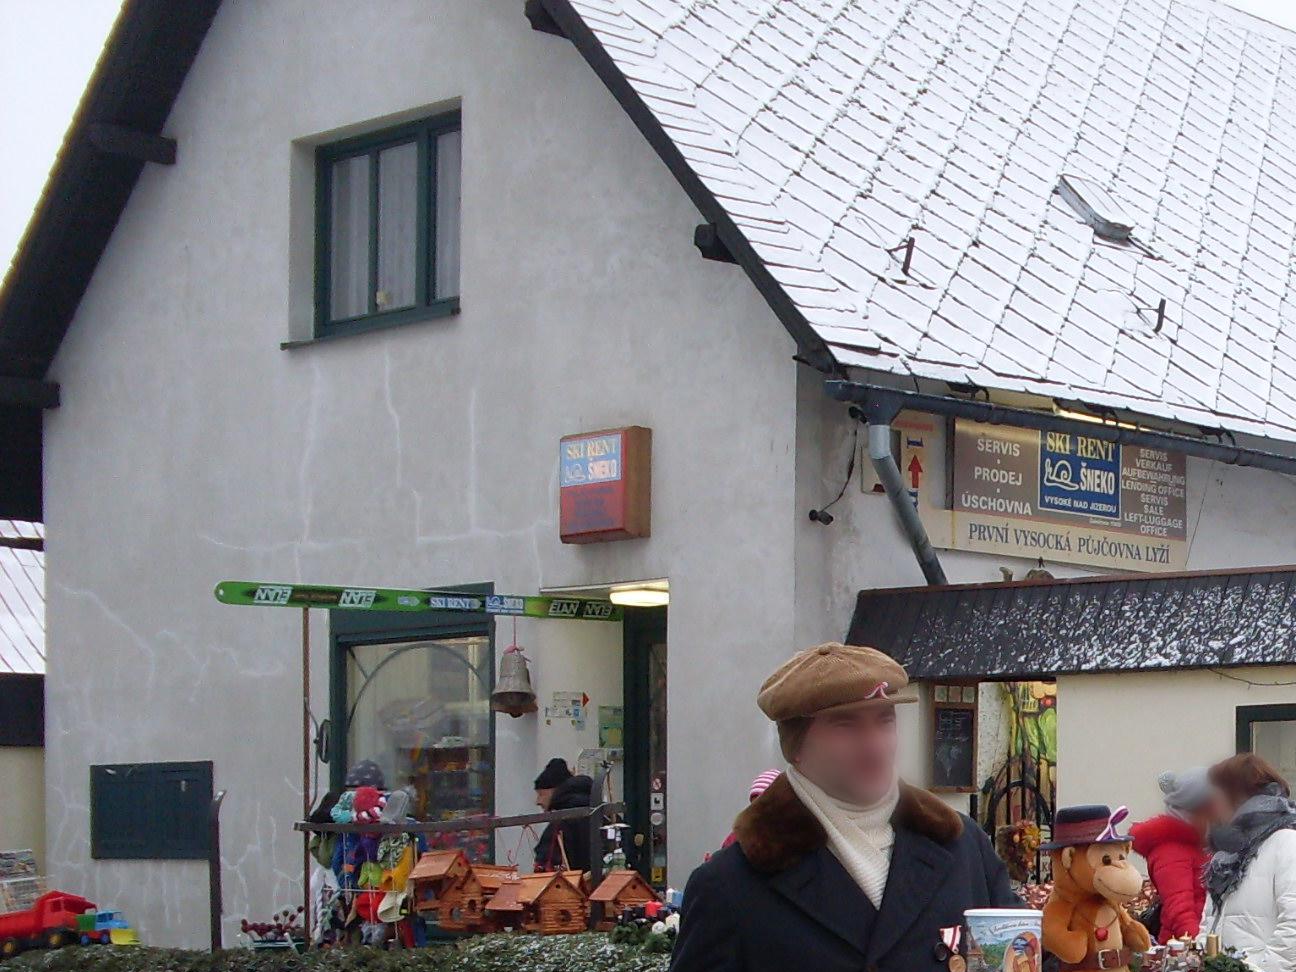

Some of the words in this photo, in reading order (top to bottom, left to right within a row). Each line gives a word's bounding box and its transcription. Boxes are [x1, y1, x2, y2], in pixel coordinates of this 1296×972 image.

[977, 438, 1020, 457] SERVIS
[1047, 432, 1071, 455] SKI
[1077, 436, 1115, 461] RENT
[1140, 449, 1167, 462] SERVIS
[1136, 459, 1172, 471] VERKAUF
[974, 466, 1022, 486] PRODEJ
[1079, 461, 1115, 495] ŠNEKO
[1122, 479, 1156, 494] LENDING
[1158, 485, 1184, 498] OFFICE
[962, 491, 1032, 515] ÚSCHOVNA
[1044, 496, 1071, 508] VYSOKÉ
[1074, 500, 1088, 509] NAD
[1090, 503, 1116, 514] JIZEROU
[1140, 493, 1168, 506] SERVIS
[1144, 504, 1164, 516] SALE
[1124, 513, 1183, 529] LEFT-LUGGAGE
[1140, 525, 1168, 537] OFFICE
[969, 522, 1009, 544] PRVNÍ
[1014, 529, 1071, 552] VYSOCKÁ
[1145, 544, 1170, 564] LYŽÍ
[550, 600, 579, 615] ELAN
